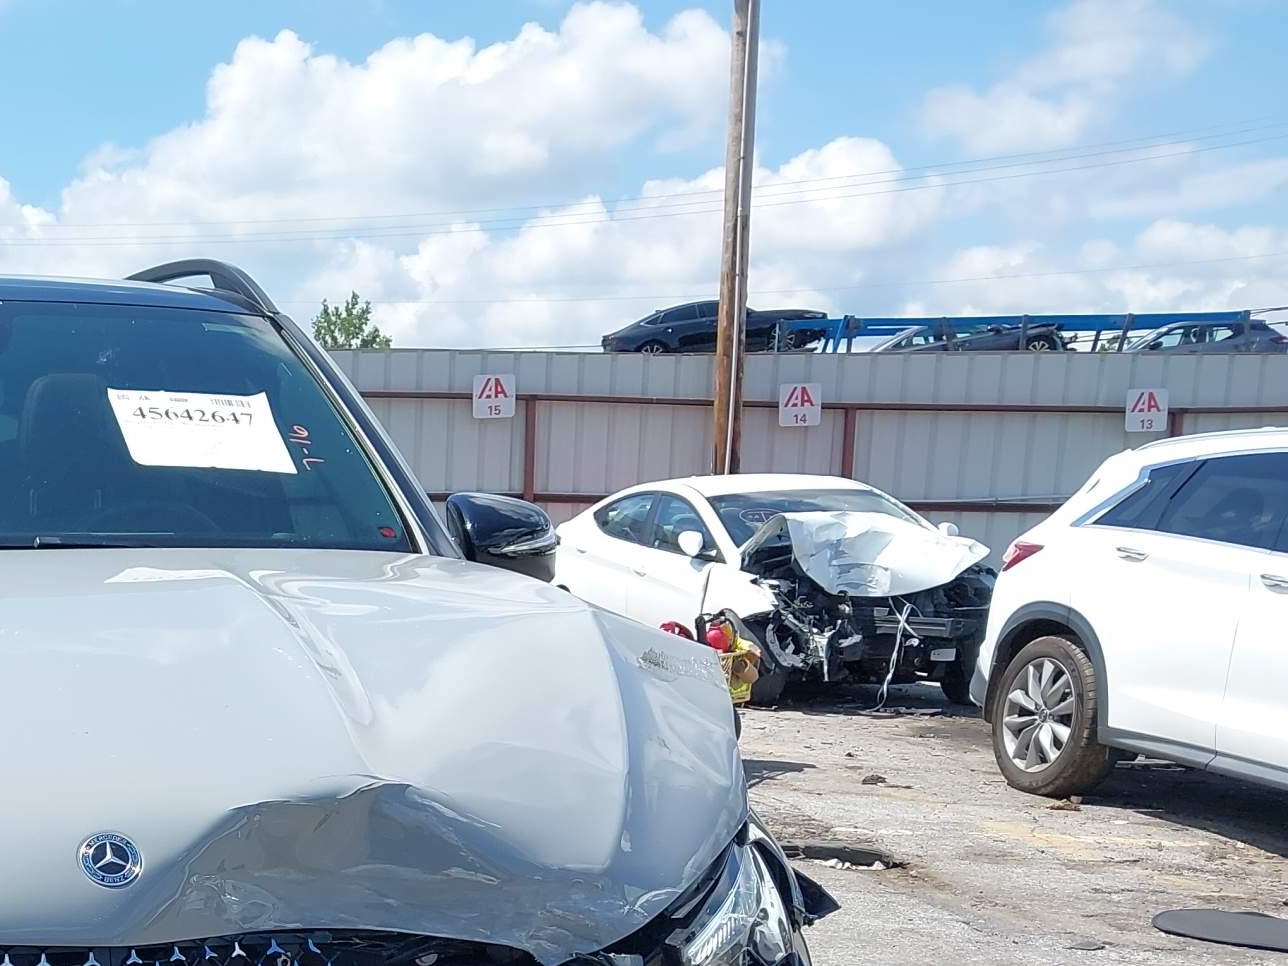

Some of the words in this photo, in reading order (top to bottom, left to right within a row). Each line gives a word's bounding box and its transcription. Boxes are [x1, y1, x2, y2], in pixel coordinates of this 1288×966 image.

[487, 404, 502, 416] 15
[132, 406, 253, 426] 45642647
[793, 413, 808, 424] 14
[1140, 419, 1153, 430] 13
